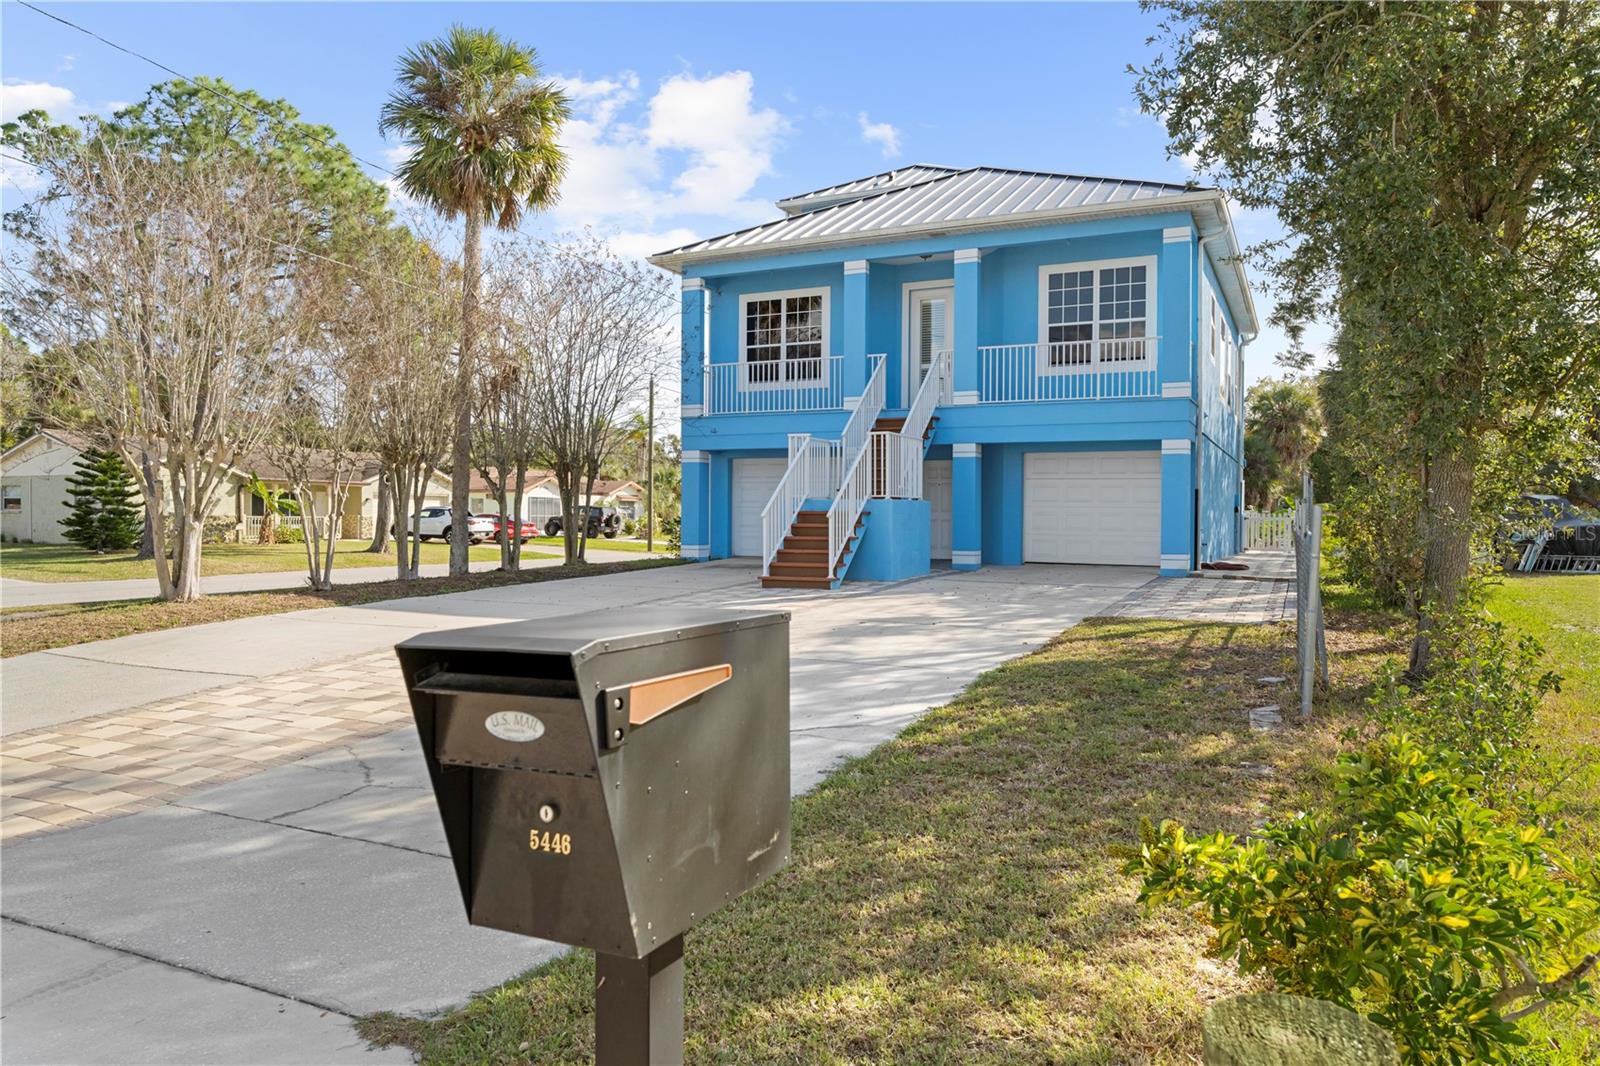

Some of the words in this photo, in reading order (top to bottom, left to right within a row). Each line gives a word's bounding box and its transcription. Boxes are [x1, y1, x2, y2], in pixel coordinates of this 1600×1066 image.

[490, 713, 511, 728] U.S.
[513, 713, 538, 732] MAIL
[529, 829, 571, 855] 5446
